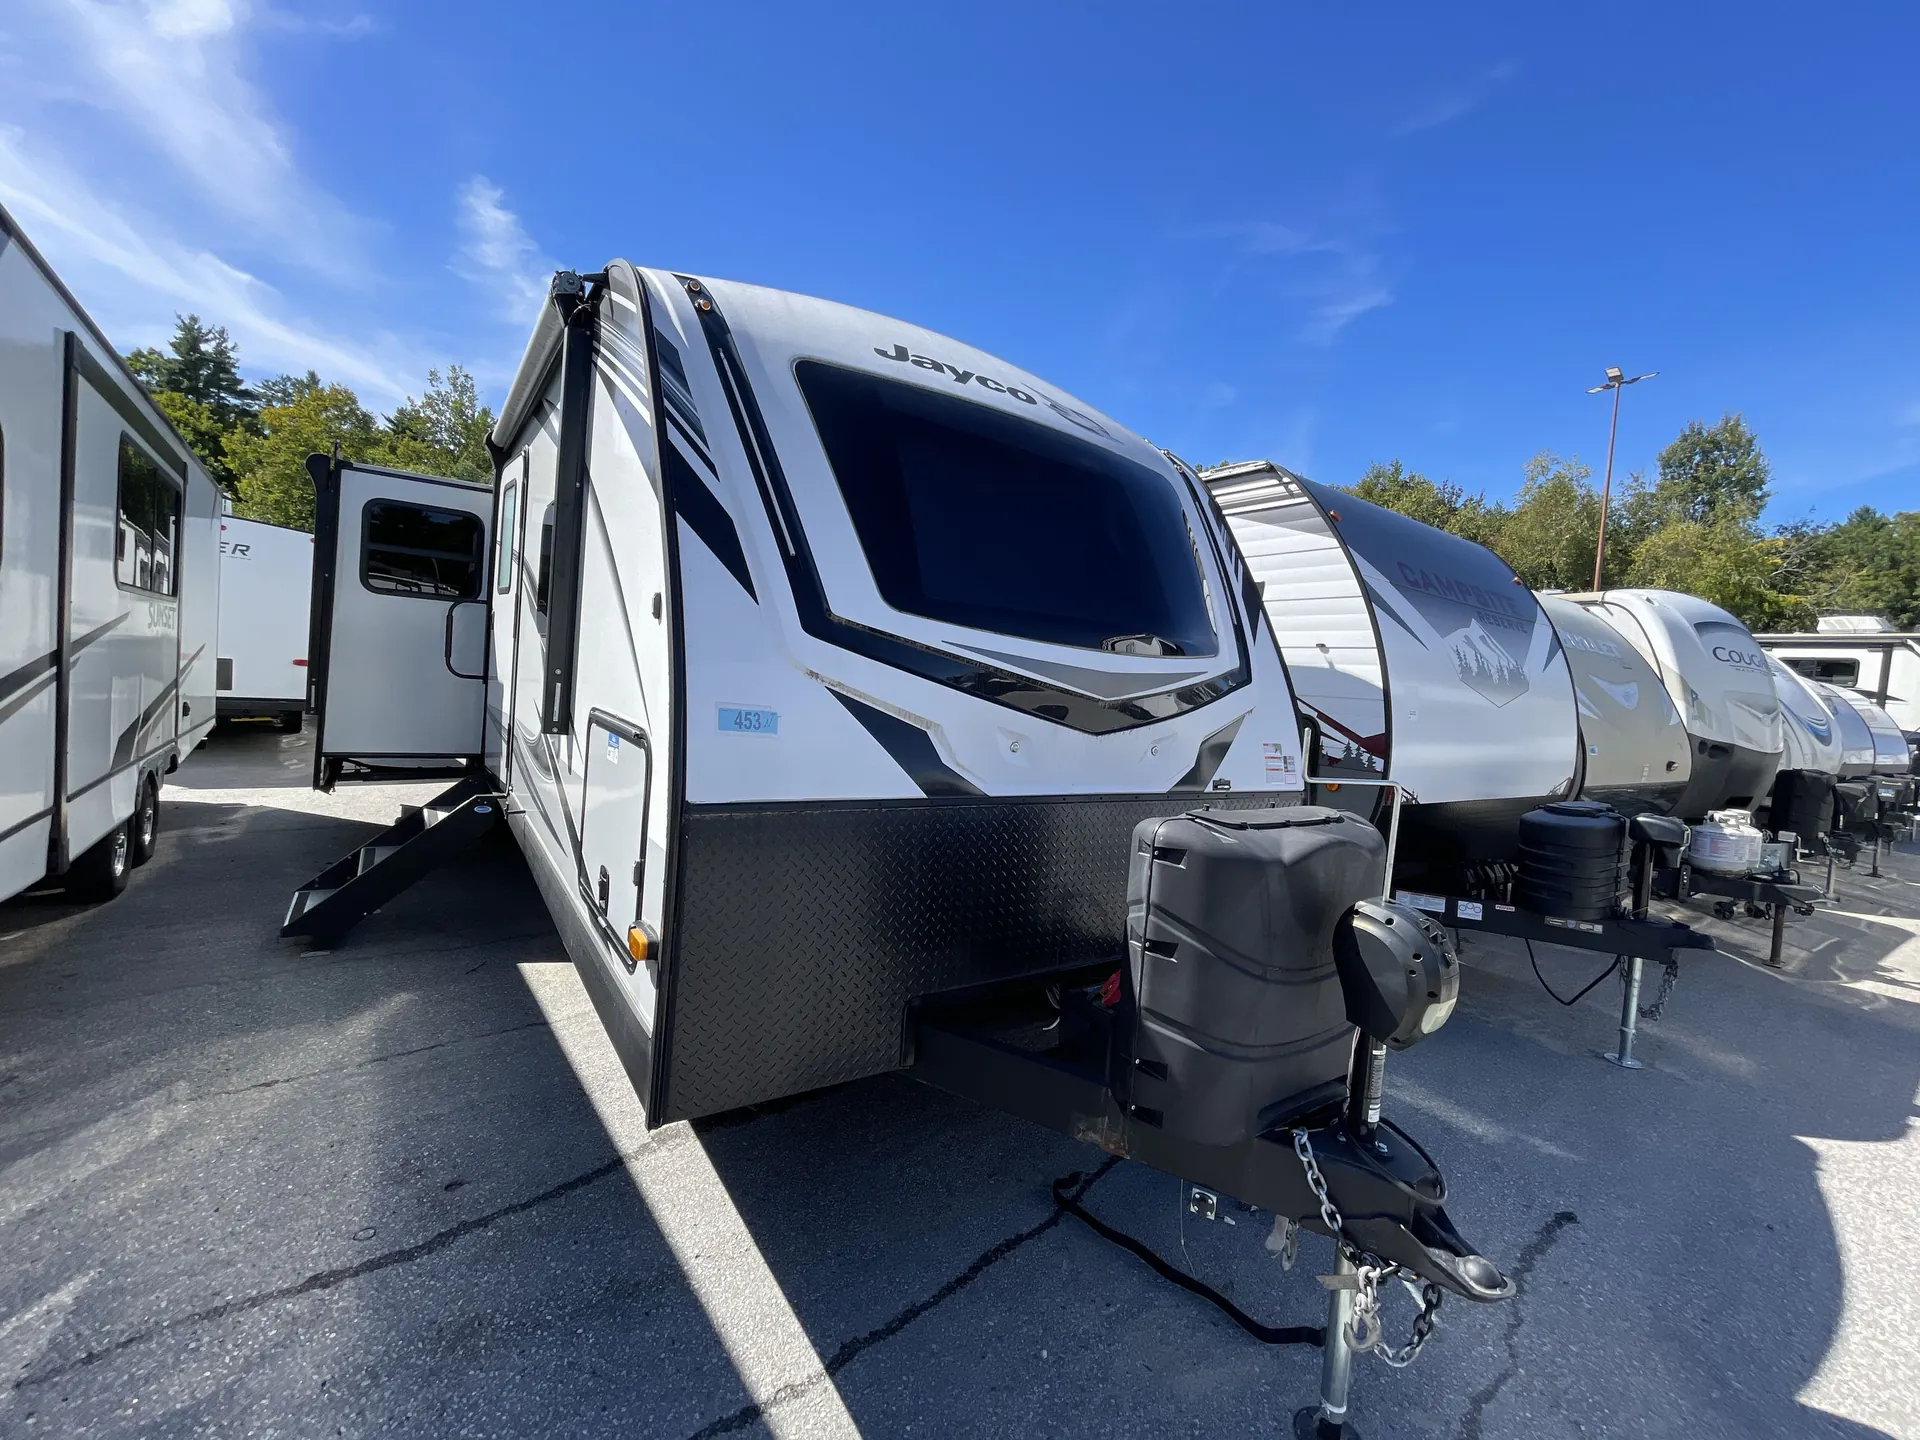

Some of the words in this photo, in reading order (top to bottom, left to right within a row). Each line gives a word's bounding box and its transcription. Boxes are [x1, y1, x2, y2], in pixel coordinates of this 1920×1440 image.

[873, 343, 1038, 405] Jayco
[1396, 561, 1524, 617] CAMPSITE
[147, 602, 176, 630] SUNSET
[1475, 610, 1528, 634] RESERVE
[734, 710, 761, 730] 453
